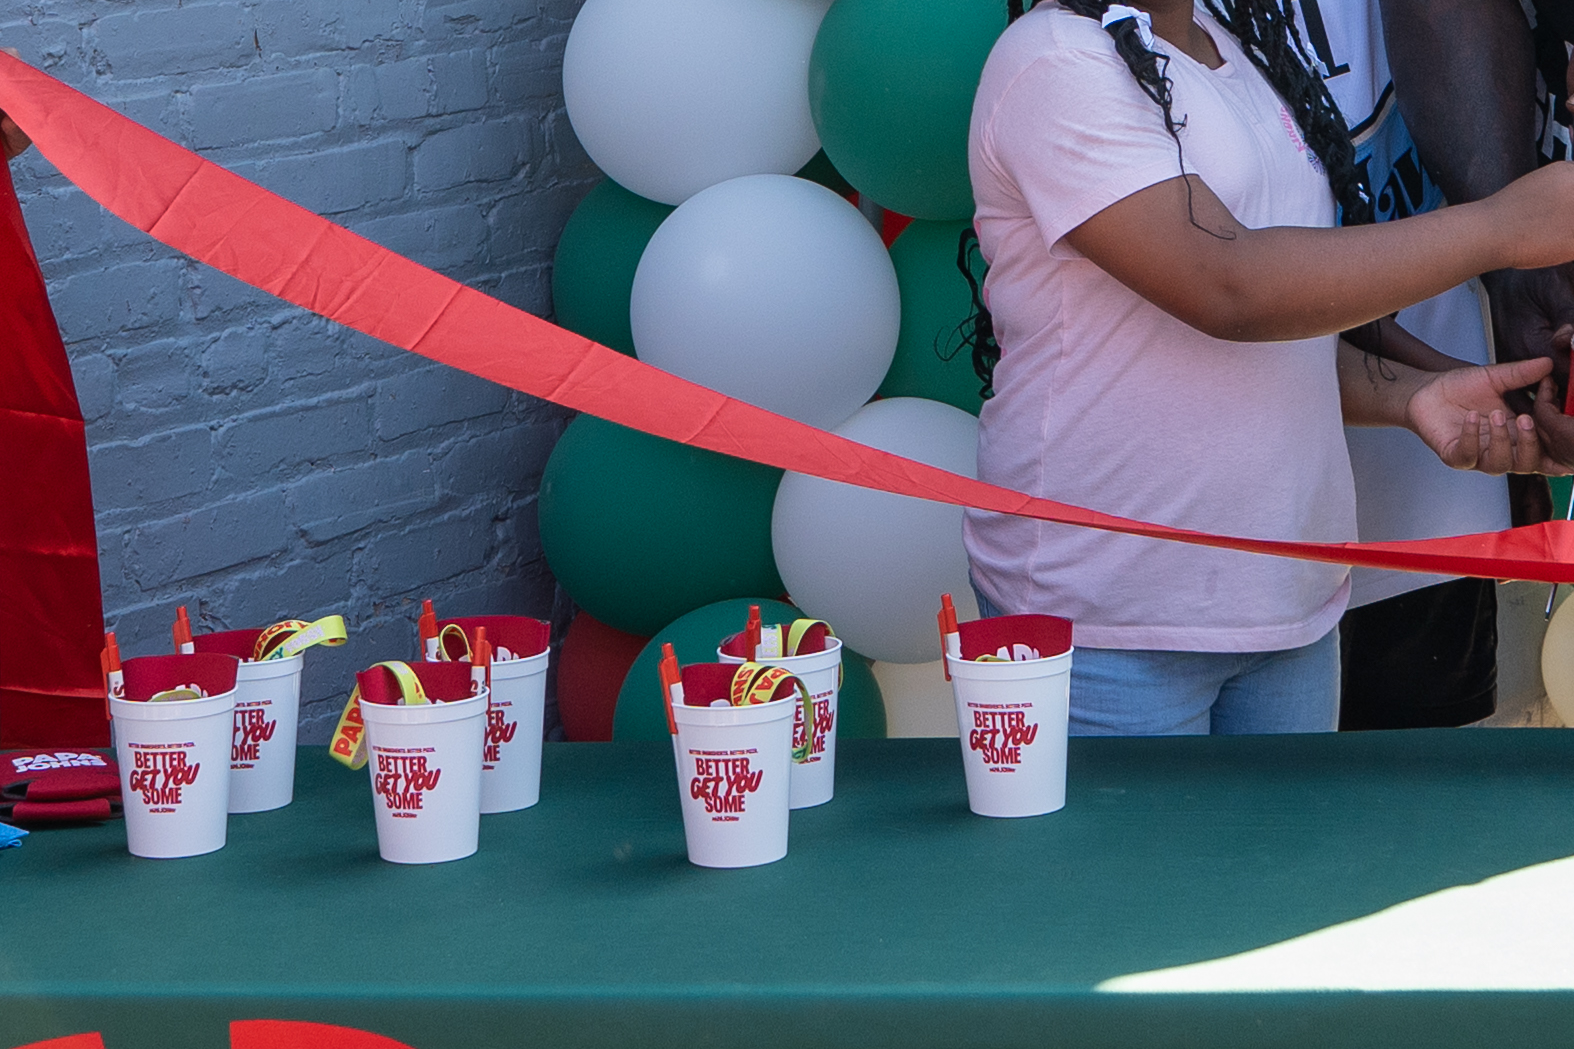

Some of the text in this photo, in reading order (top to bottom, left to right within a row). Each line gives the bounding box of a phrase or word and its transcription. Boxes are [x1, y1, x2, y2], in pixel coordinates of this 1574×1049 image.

[973, 710, 1026, 729] BETTER
[241, 720, 277, 745] YOU
[969, 723, 1038, 751] GET YOU
[12, 753, 99, 766] PAPA
[134, 751, 187, 769] BETTER
[231, 743, 260, 762] OME
[982, 747, 1021, 765] SOME
[377, 754, 428, 773] BETTER
[695, 757, 750, 776] BETTER
[130, 762, 200, 792] GET YOU
[375, 768, 441, 795] GET YOU
[690, 769, 763, 800] GET YOU
[142, 787, 182, 805] SOME
[385, 792, 423, 810] SOME
[704, 794, 746, 813] SOME
